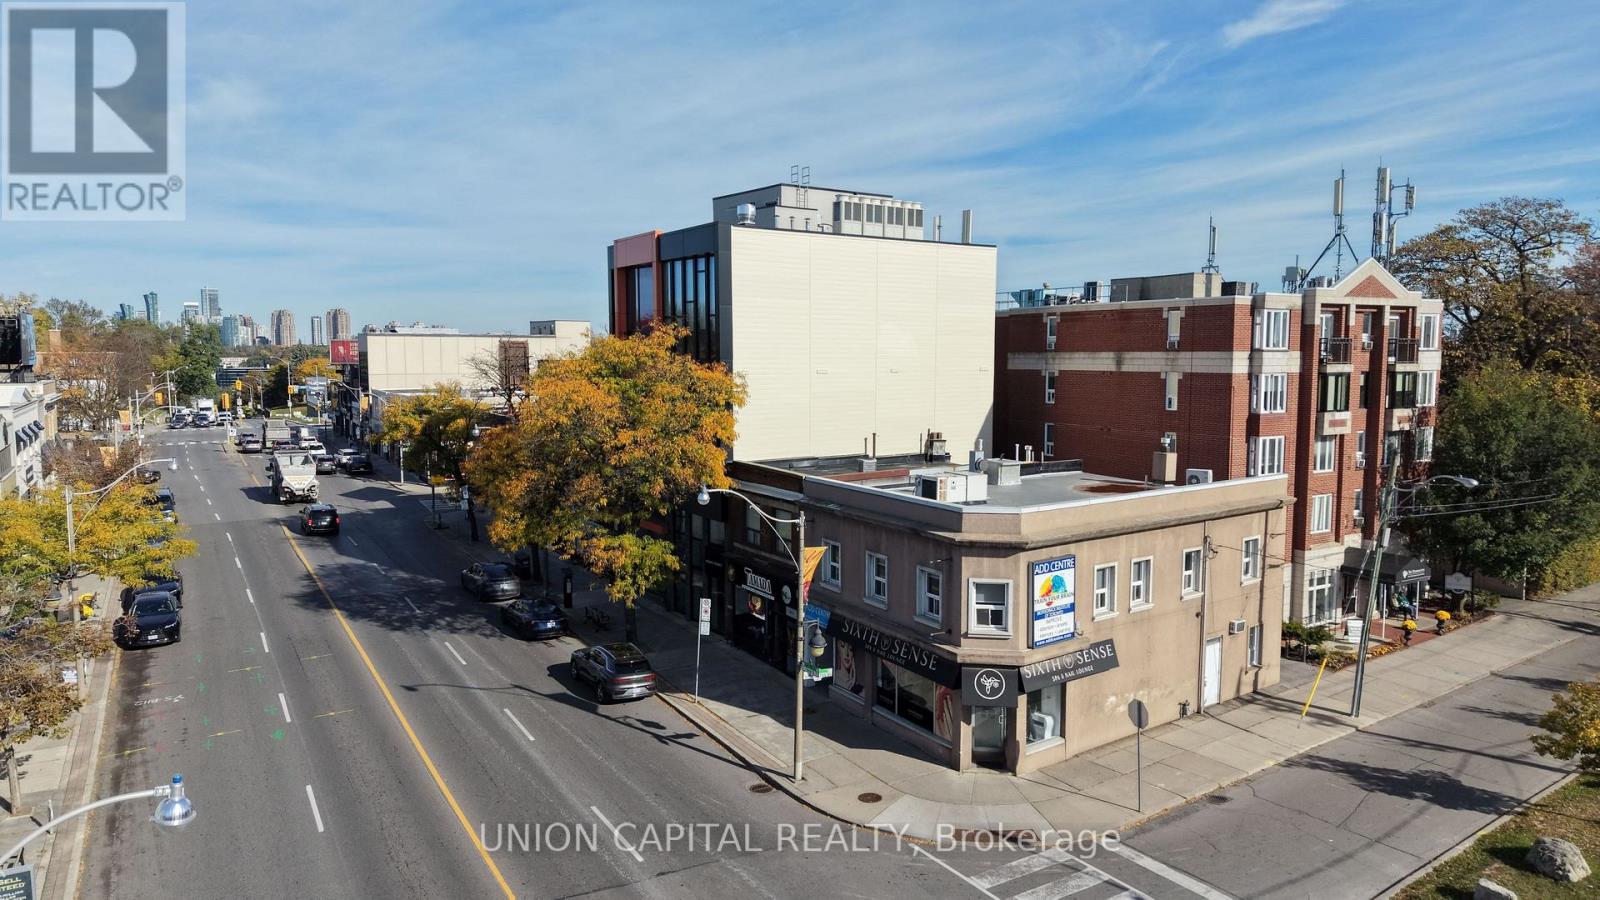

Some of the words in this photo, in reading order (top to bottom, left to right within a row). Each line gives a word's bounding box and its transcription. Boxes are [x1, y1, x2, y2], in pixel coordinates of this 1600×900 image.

[1034, 562, 1049, 575] ADD
[1050, 557, 1075, 572] CENTRE
[841, 618, 880, 645] SIXTH
[892, 639, 938, 671] SENSE
[1023, 658, 1061, 679] SIXTH
[1076, 644, 1114, 664] SENSE
[0, 882, 25, 892] TEED
